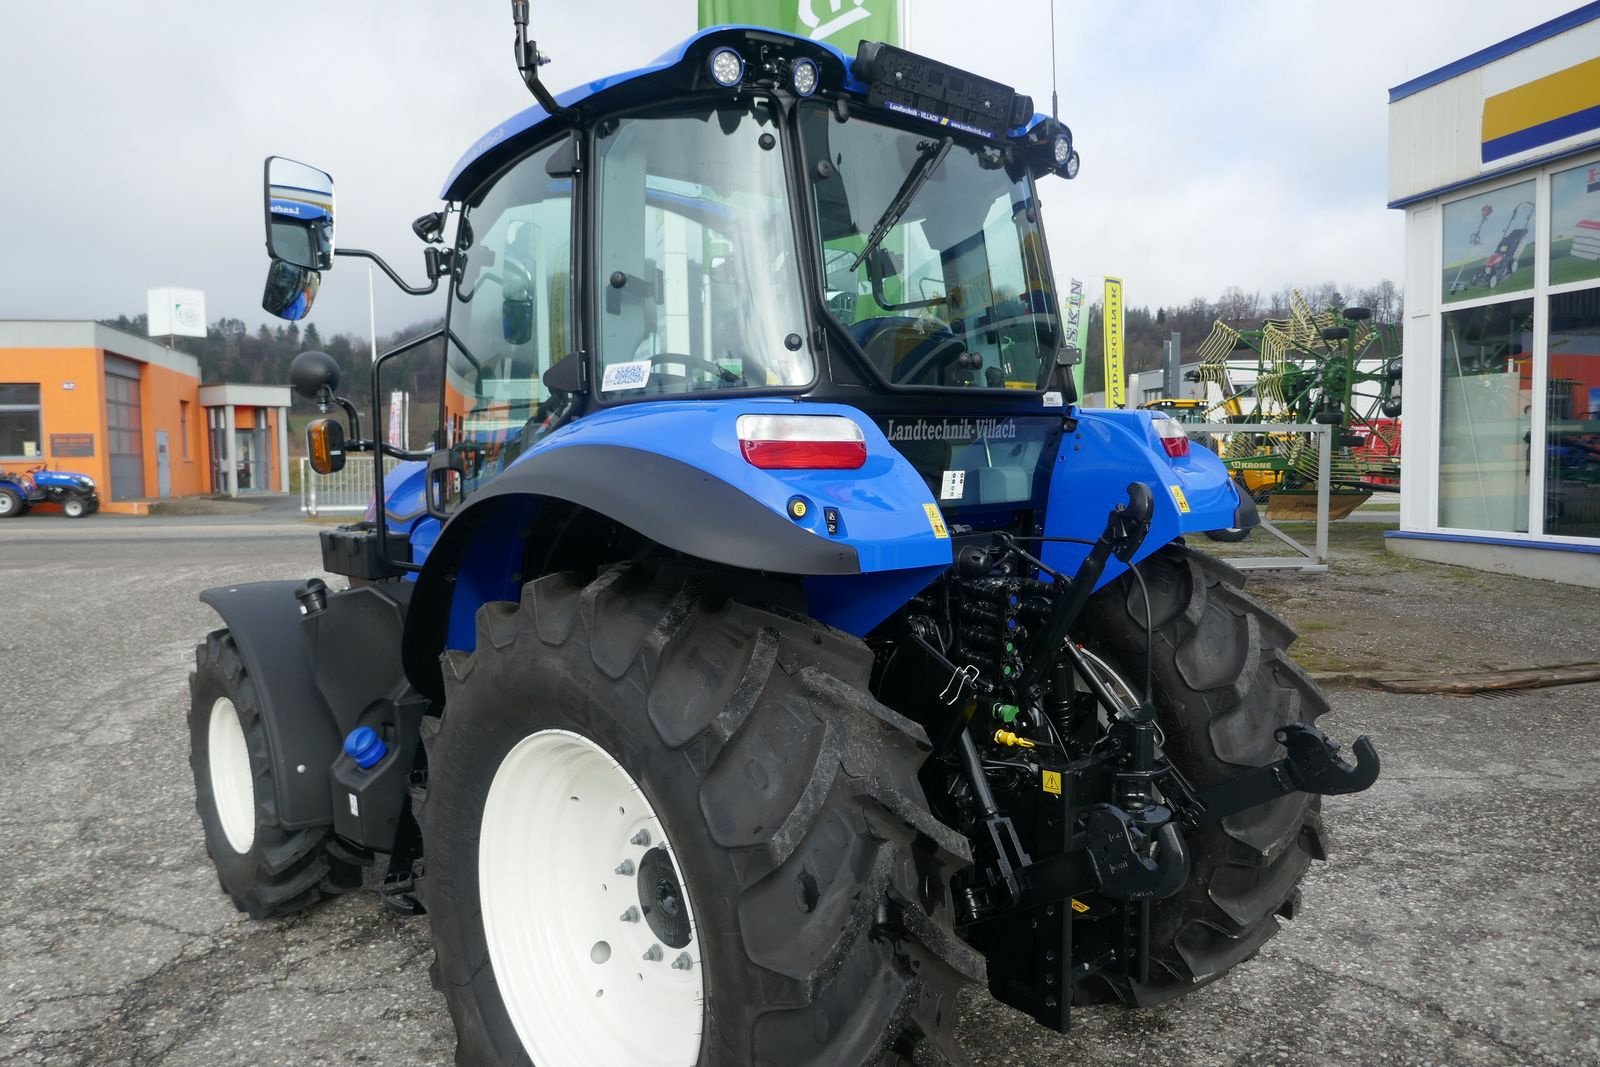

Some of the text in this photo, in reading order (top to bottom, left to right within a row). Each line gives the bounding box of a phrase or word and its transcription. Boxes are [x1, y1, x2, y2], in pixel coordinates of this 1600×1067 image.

[889, 102, 918, 117] Landtechnik
[920, 111, 939, 122] VILLACH
[617, 365, 641, 373] CLEAN
[887, 418, 1016, 441] Landtechnik-Villach
